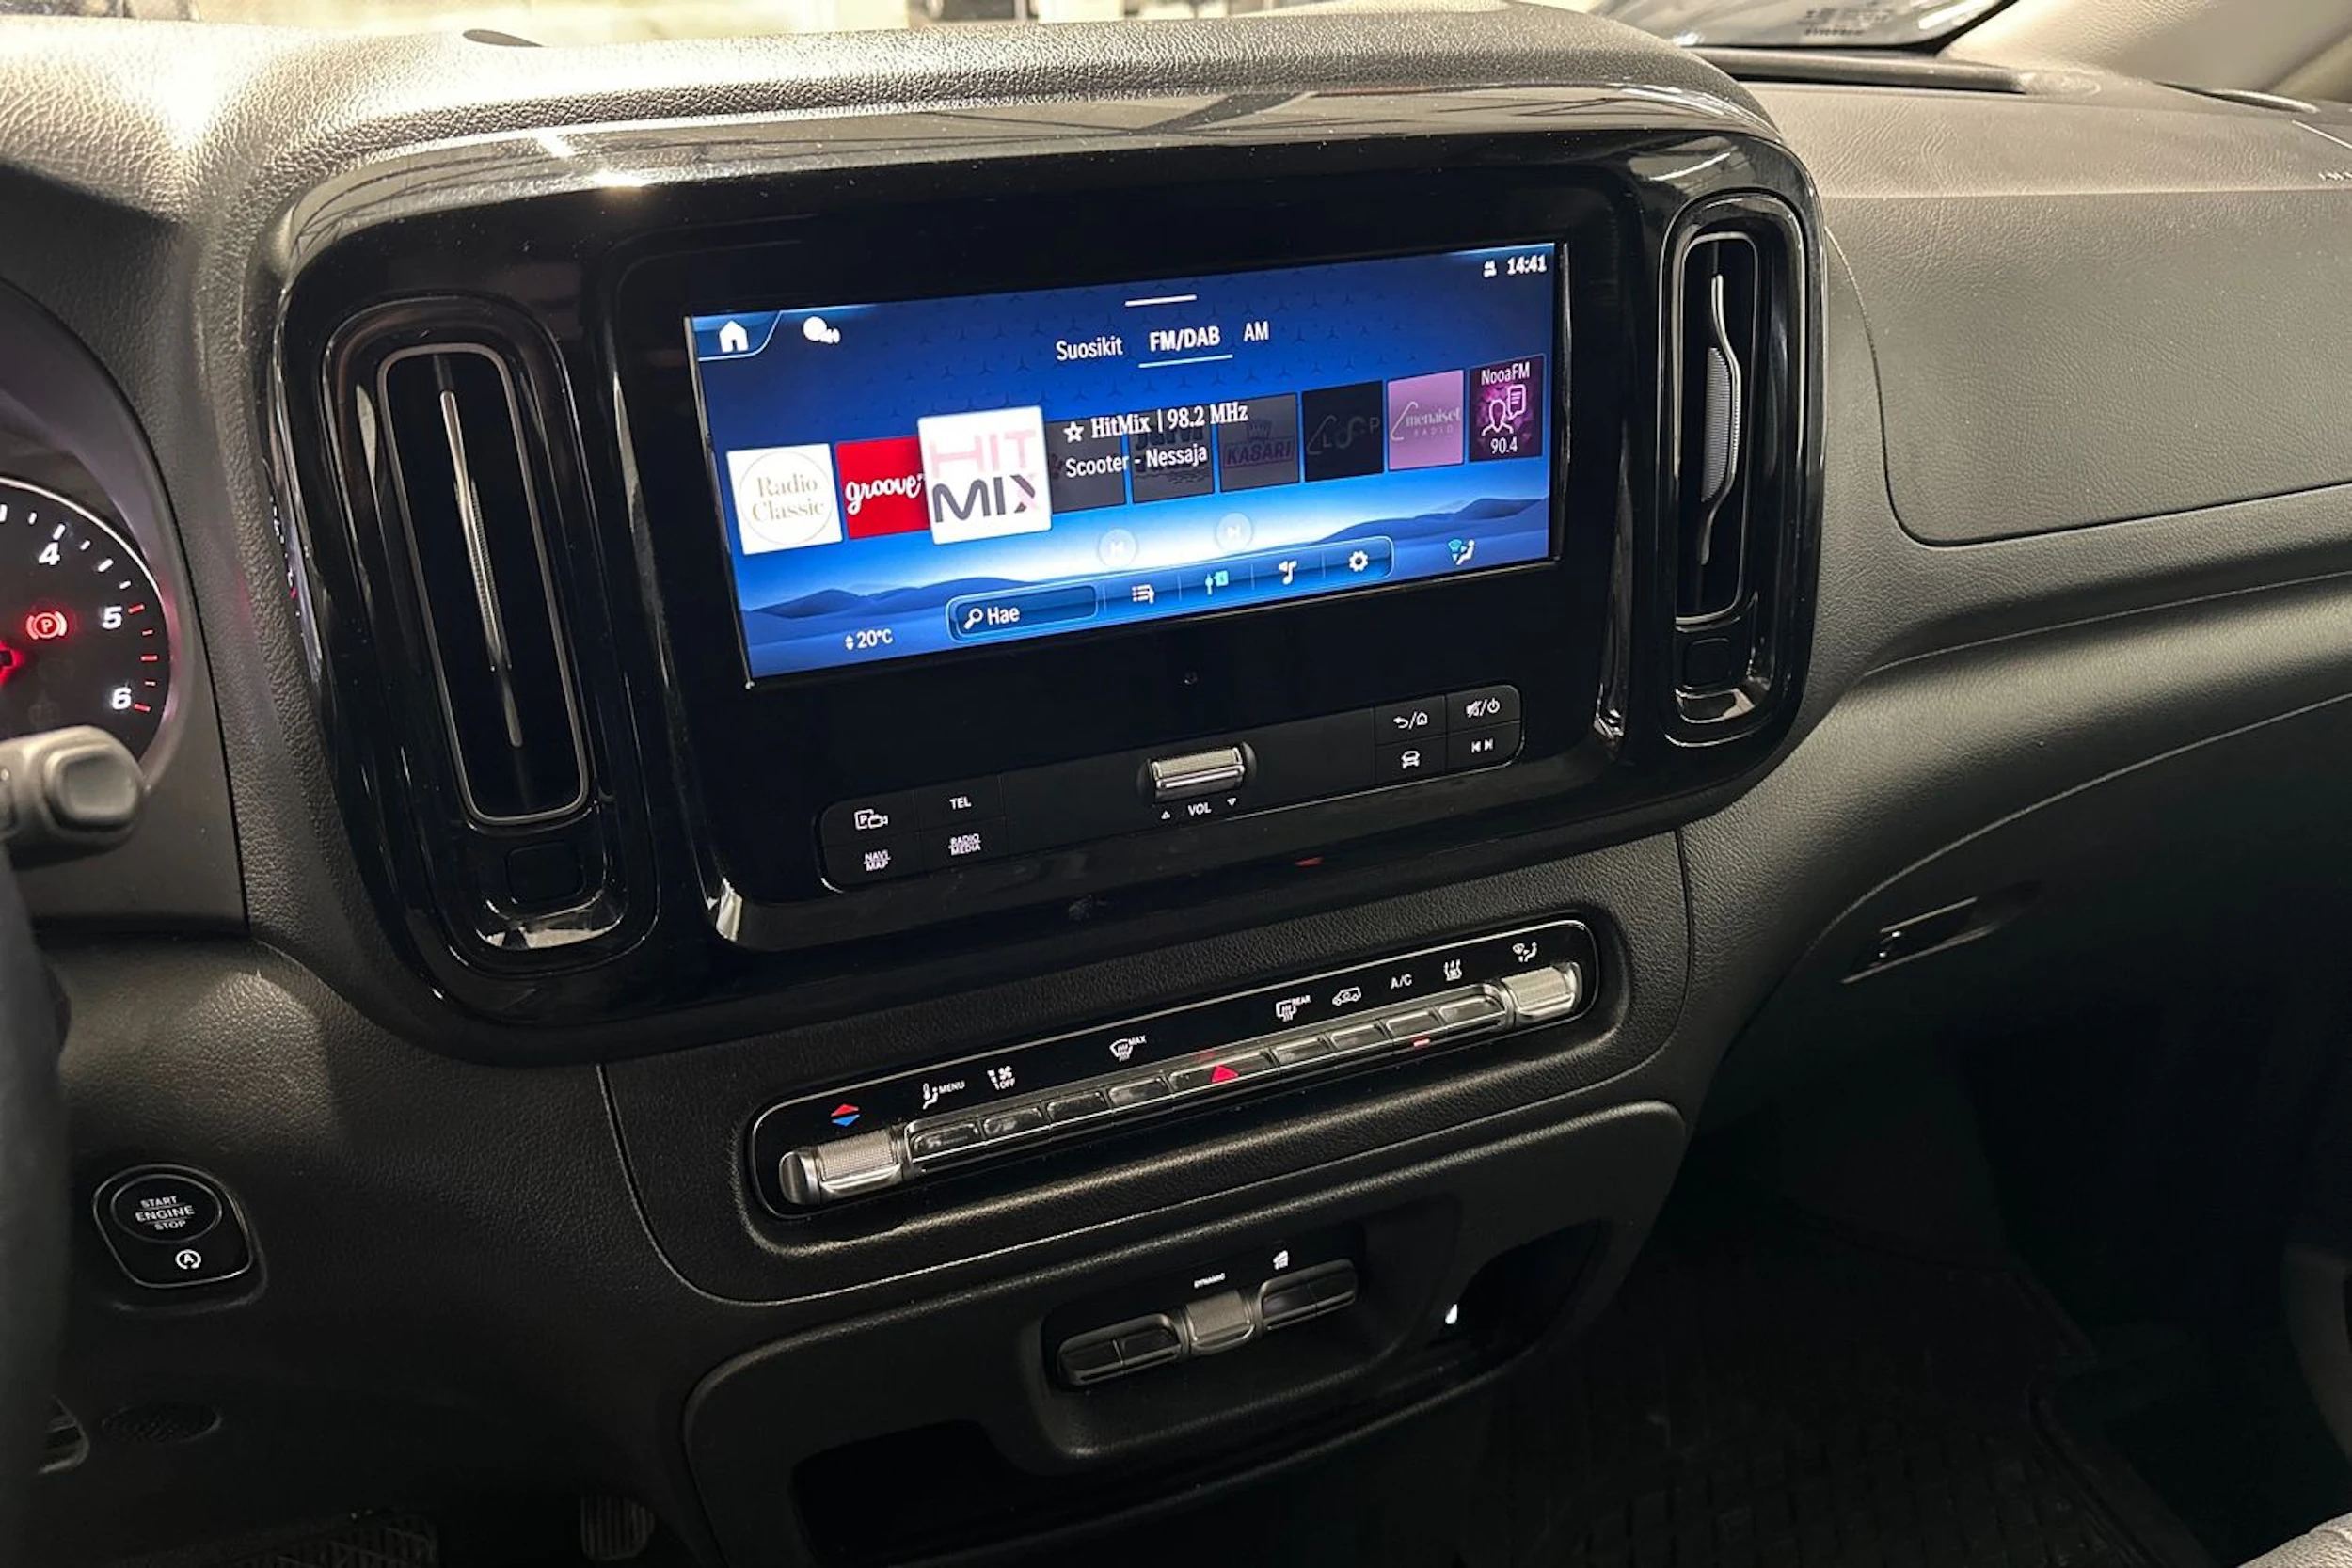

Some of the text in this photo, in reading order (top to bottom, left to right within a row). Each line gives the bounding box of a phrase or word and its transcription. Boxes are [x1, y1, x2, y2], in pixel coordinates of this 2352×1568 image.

[1507, 254, 1548, 276] 14:41
[1056, 321, 1270, 361] Suosikit FM/DAB AM
[1481, 361, 1530, 386] NooaFM
[1090, 412, 1151, 439] HitMix
[1167, 405, 1205, 430] 98.2
[1210, 402, 1248, 424] MHz
[1406, 407, 1461, 428] menaiset
[930, 429, 1036, 477] HIT
[1226, 439, 1293, 466] KASARI
[1490, 436, 1518, 455] 90.4
[1065, 455, 1129, 478] Scooter
[1145, 444, 1208, 468] Nessaja
[756, 473, 818, 498] Radio
[932, 473, 1039, 523] MIX
[752, 498, 825, 522] Classic
[38, 542, 60, 566] 4
[103, 607, 122, 629] 5
[987, 605, 1020, 625] Hae
[856, 628, 893, 649] 20°C
[112, 688, 132, 710] 6
[949, 796, 972, 810] TEL
[1187, 802, 1212, 816] VOL
[949, 833, 980, 847] RADIO
[950, 843, 981, 856] MEDIA
[864, 850, 890, 863] NAVI
[866, 860, 889, 872] MAP
[1391, 973, 1412, 989] A/C
[1128, 1035, 1147, 1047] MAX
[938, 1080, 966, 1095] MENU
[999, 1077, 1016, 1089] OFF
[140, 1196, 177, 1208] START
[135, 1205, 195, 1222] ENGINE
[153, 1220, 186, 1231] STOP
